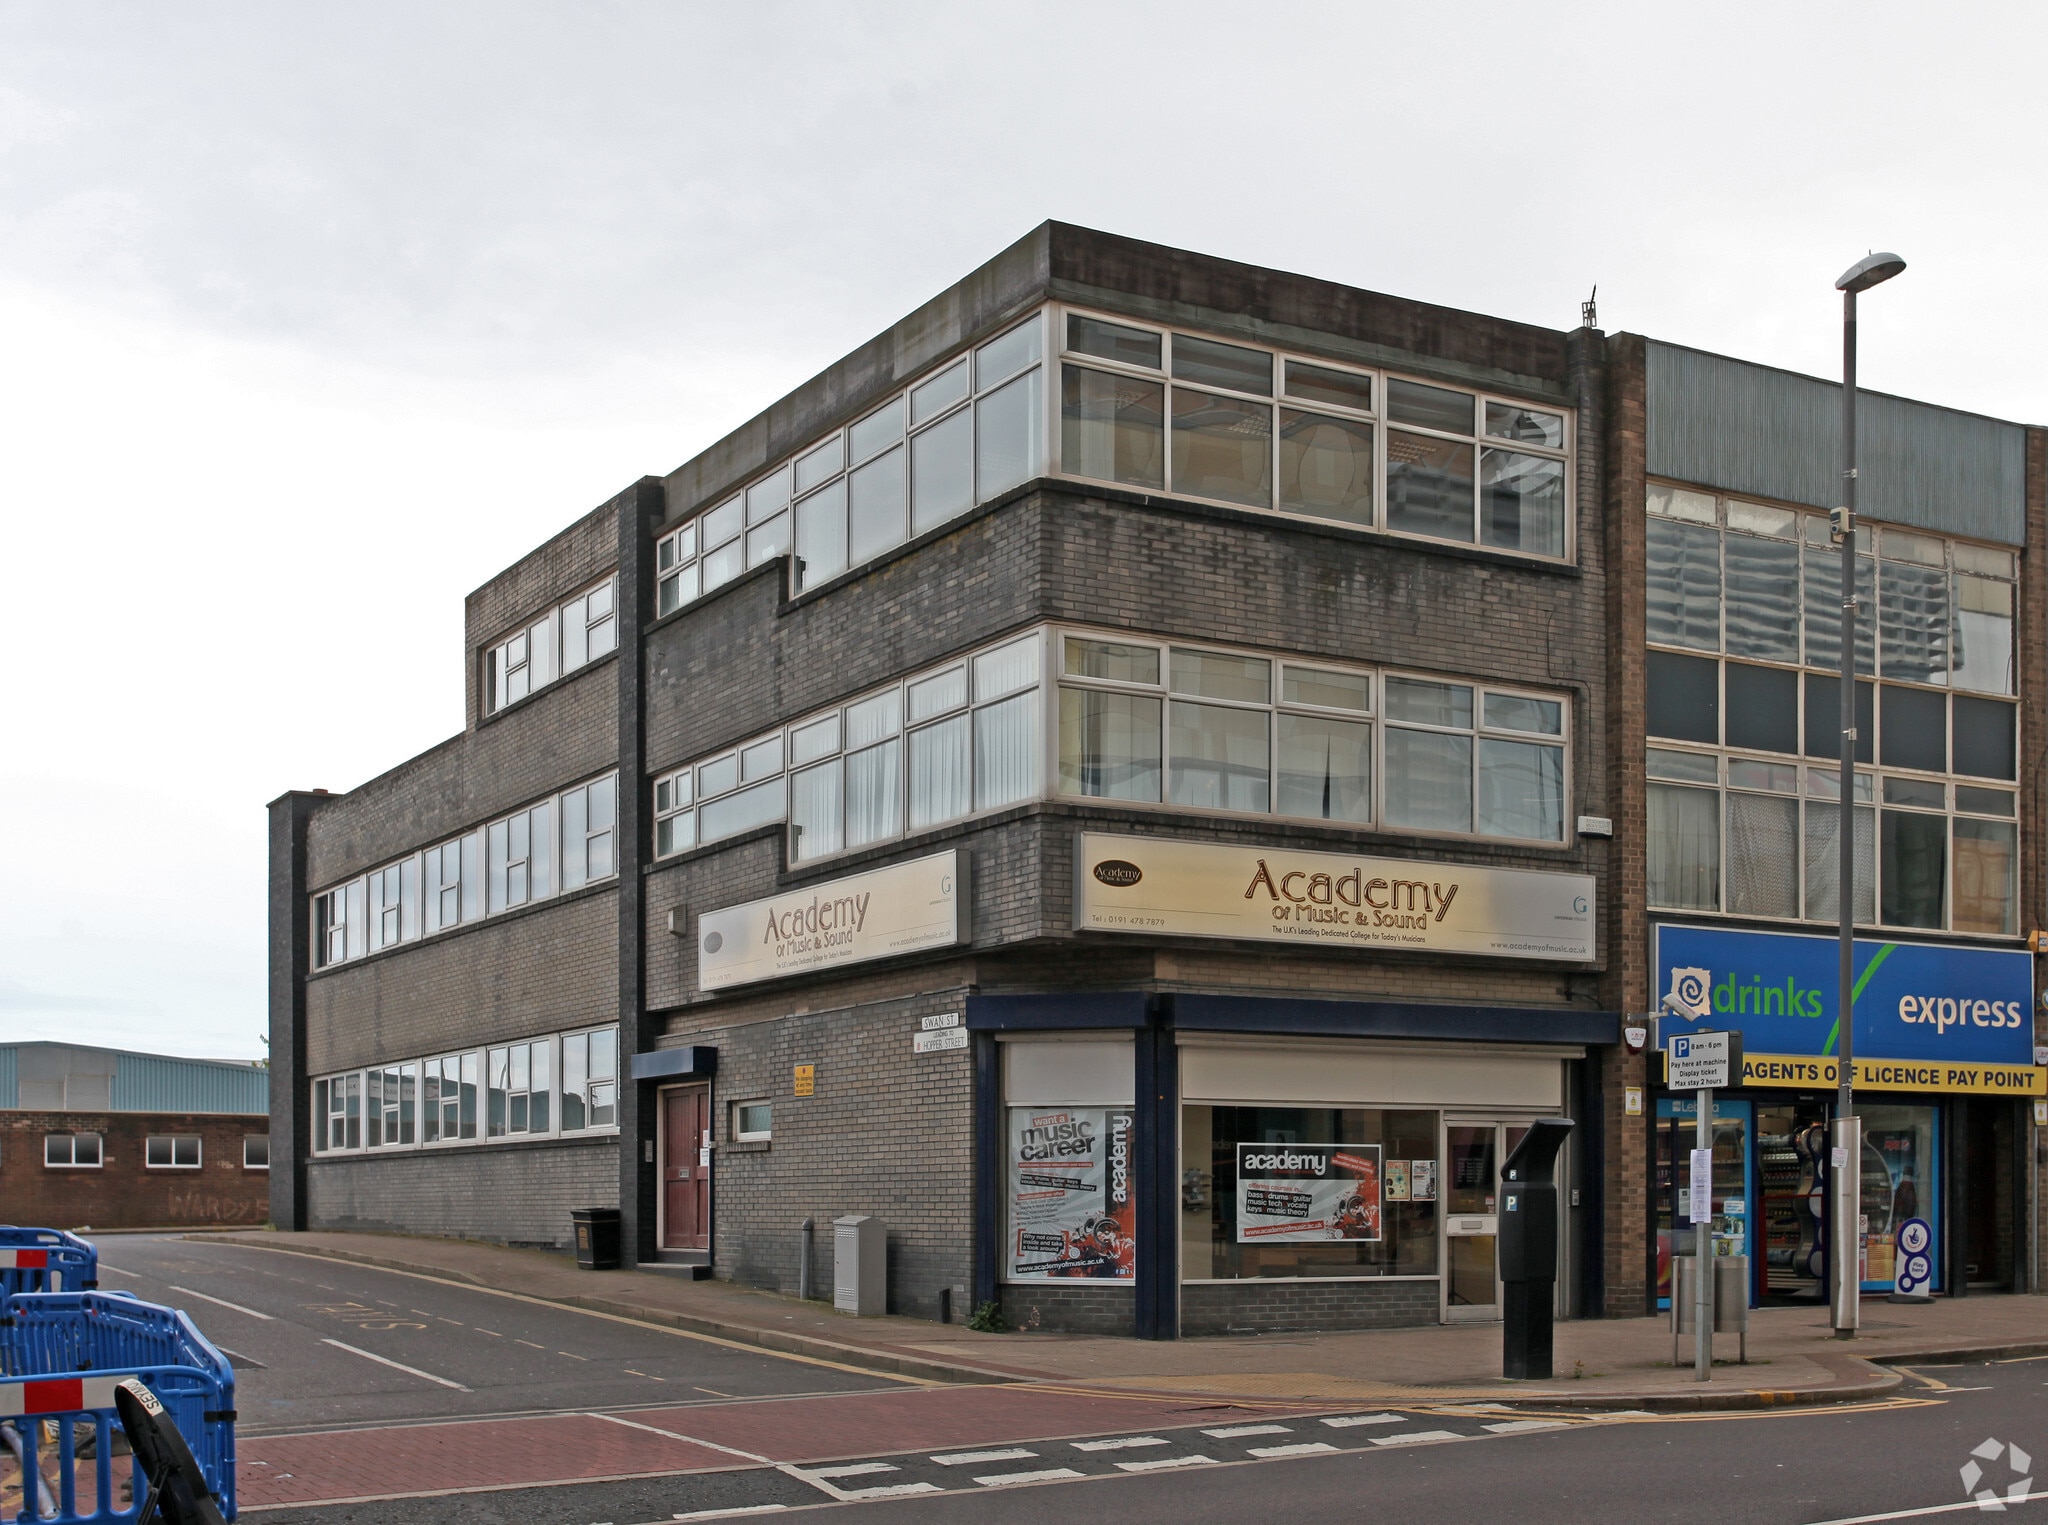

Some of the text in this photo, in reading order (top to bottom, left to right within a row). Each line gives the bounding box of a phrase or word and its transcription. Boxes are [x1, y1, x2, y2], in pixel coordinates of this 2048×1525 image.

[1095, 866, 1141, 880] Academy
[1244, 859, 1459, 921] Academy
[1573, 896, 1587, 914] G
[763, 892, 870, 944] Academy
[1146, 918, 1165, 926] 7879
[1296, 904, 1349, 924] Music
[1355, 911, 1369, 925] &
[1373, 910, 1427, 930] Sound
[787, 937, 812, 956] Music
[814, 936, 822, 950] &
[824, 927, 853, 948] Sound
[1272, 926, 1282, 934] The
[1298, 927, 1320, 938] Leading
[1321, 929, 1349, 938] Dedicated
[1350, 930, 1370, 941] College
[1371, 931, 1380, 940] for
[1381, 932, 1400, 942] Today's
[1402, 934, 1425, 943] Musicians
[1490, 941, 1586, 954] www.academyofmusic.ac.uk
[1713, 973, 1823, 1018] drinks
[924, 1016, 944, 1028] SWAN
[1899, 995, 2022, 1035] express
[923, 1039, 943, 1050] HOPPER
[945, 1036, 965, 1048] STREET
[1678, 1040, 1687, 1056] P
[1671, 1061, 1680, 1069] Pay
[1865, 1066, 1940, 1085] LICENCE
[1947, 1070, 1978, 1086] PAY
[1984, 1071, 2035, 1088] POINT
[1034, 1115, 1058, 1126] want
[1021, 1117, 1091, 1145] music
[1020, 1136, 1095, 1161] career
[1108, 1115, 1132, 1202] academy
[1245, 1150, 1326, 1175] academy
[1248, 1183, 1270, 1191] offering
[1247, 1205, 1262, 1213] keys
[1288, 1208, 1307, 1217] theory
[1508, 1196, 1516, 1210] P
[1245, 1222, 1323, 1236] www.academyofmusic.ac.uk
[1017, 1258, 1105, 1272] www.academyofmusic.ac.uk
